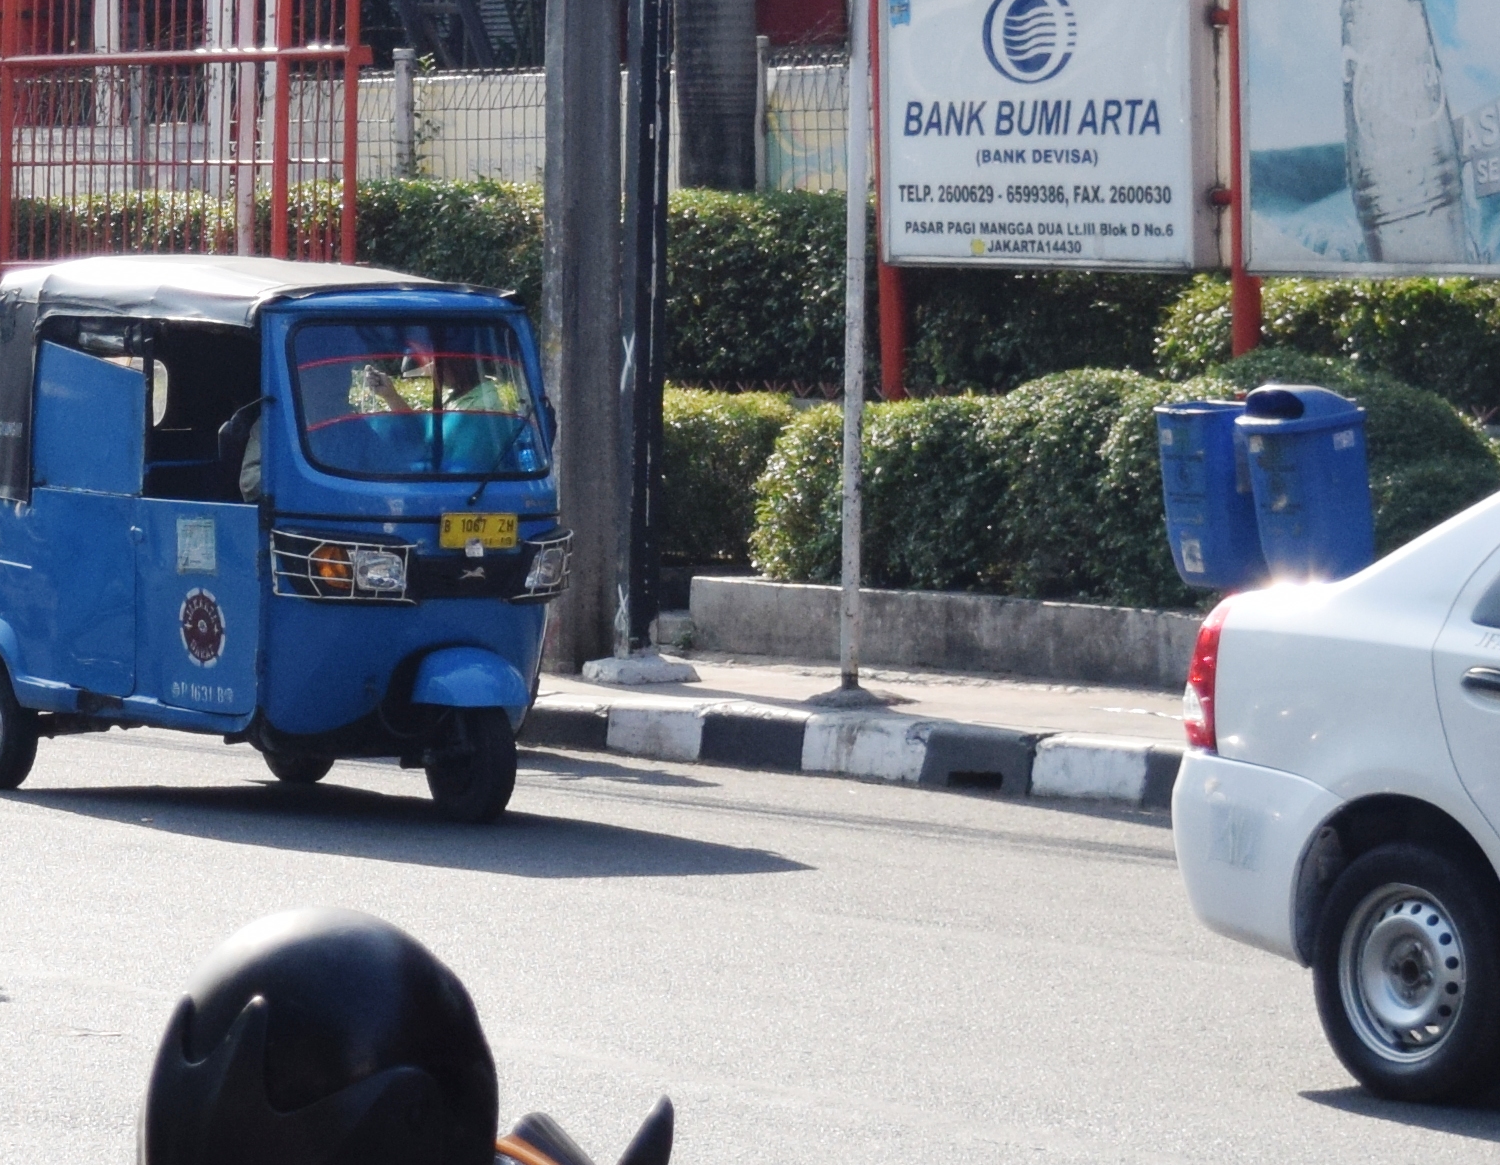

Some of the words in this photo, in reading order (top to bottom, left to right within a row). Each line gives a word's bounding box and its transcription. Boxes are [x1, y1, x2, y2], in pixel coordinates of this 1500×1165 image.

[904, 100, 987, 136] BANK
[995, 100, 1072, 136] BUMI
[1077, 99, 1161, 135] ARTA
[976, 149, 1027, 167] (BANK
[1032, 149, 1099, 167] DEVISA)
[899, 185, 935, 203] TELP.
[938, 186, 994, 203] 2600629
[1006, 187, 1069, 207] 6599386,
[1073, 187, 1105, 204] FAX.
[1109, 187, 1172, 204] 2600630
[905, 221, 944, 234] PASAR
[947, 222, 975, 235] PAGI
[979, 222, 1033, 236] MANGGA
[1038, 223, 1063, 236] DUA
[1100, 223, 1126, 236] Blok
[1132, 224, 1140, 236] D
[444, 519, 452, 533] B
